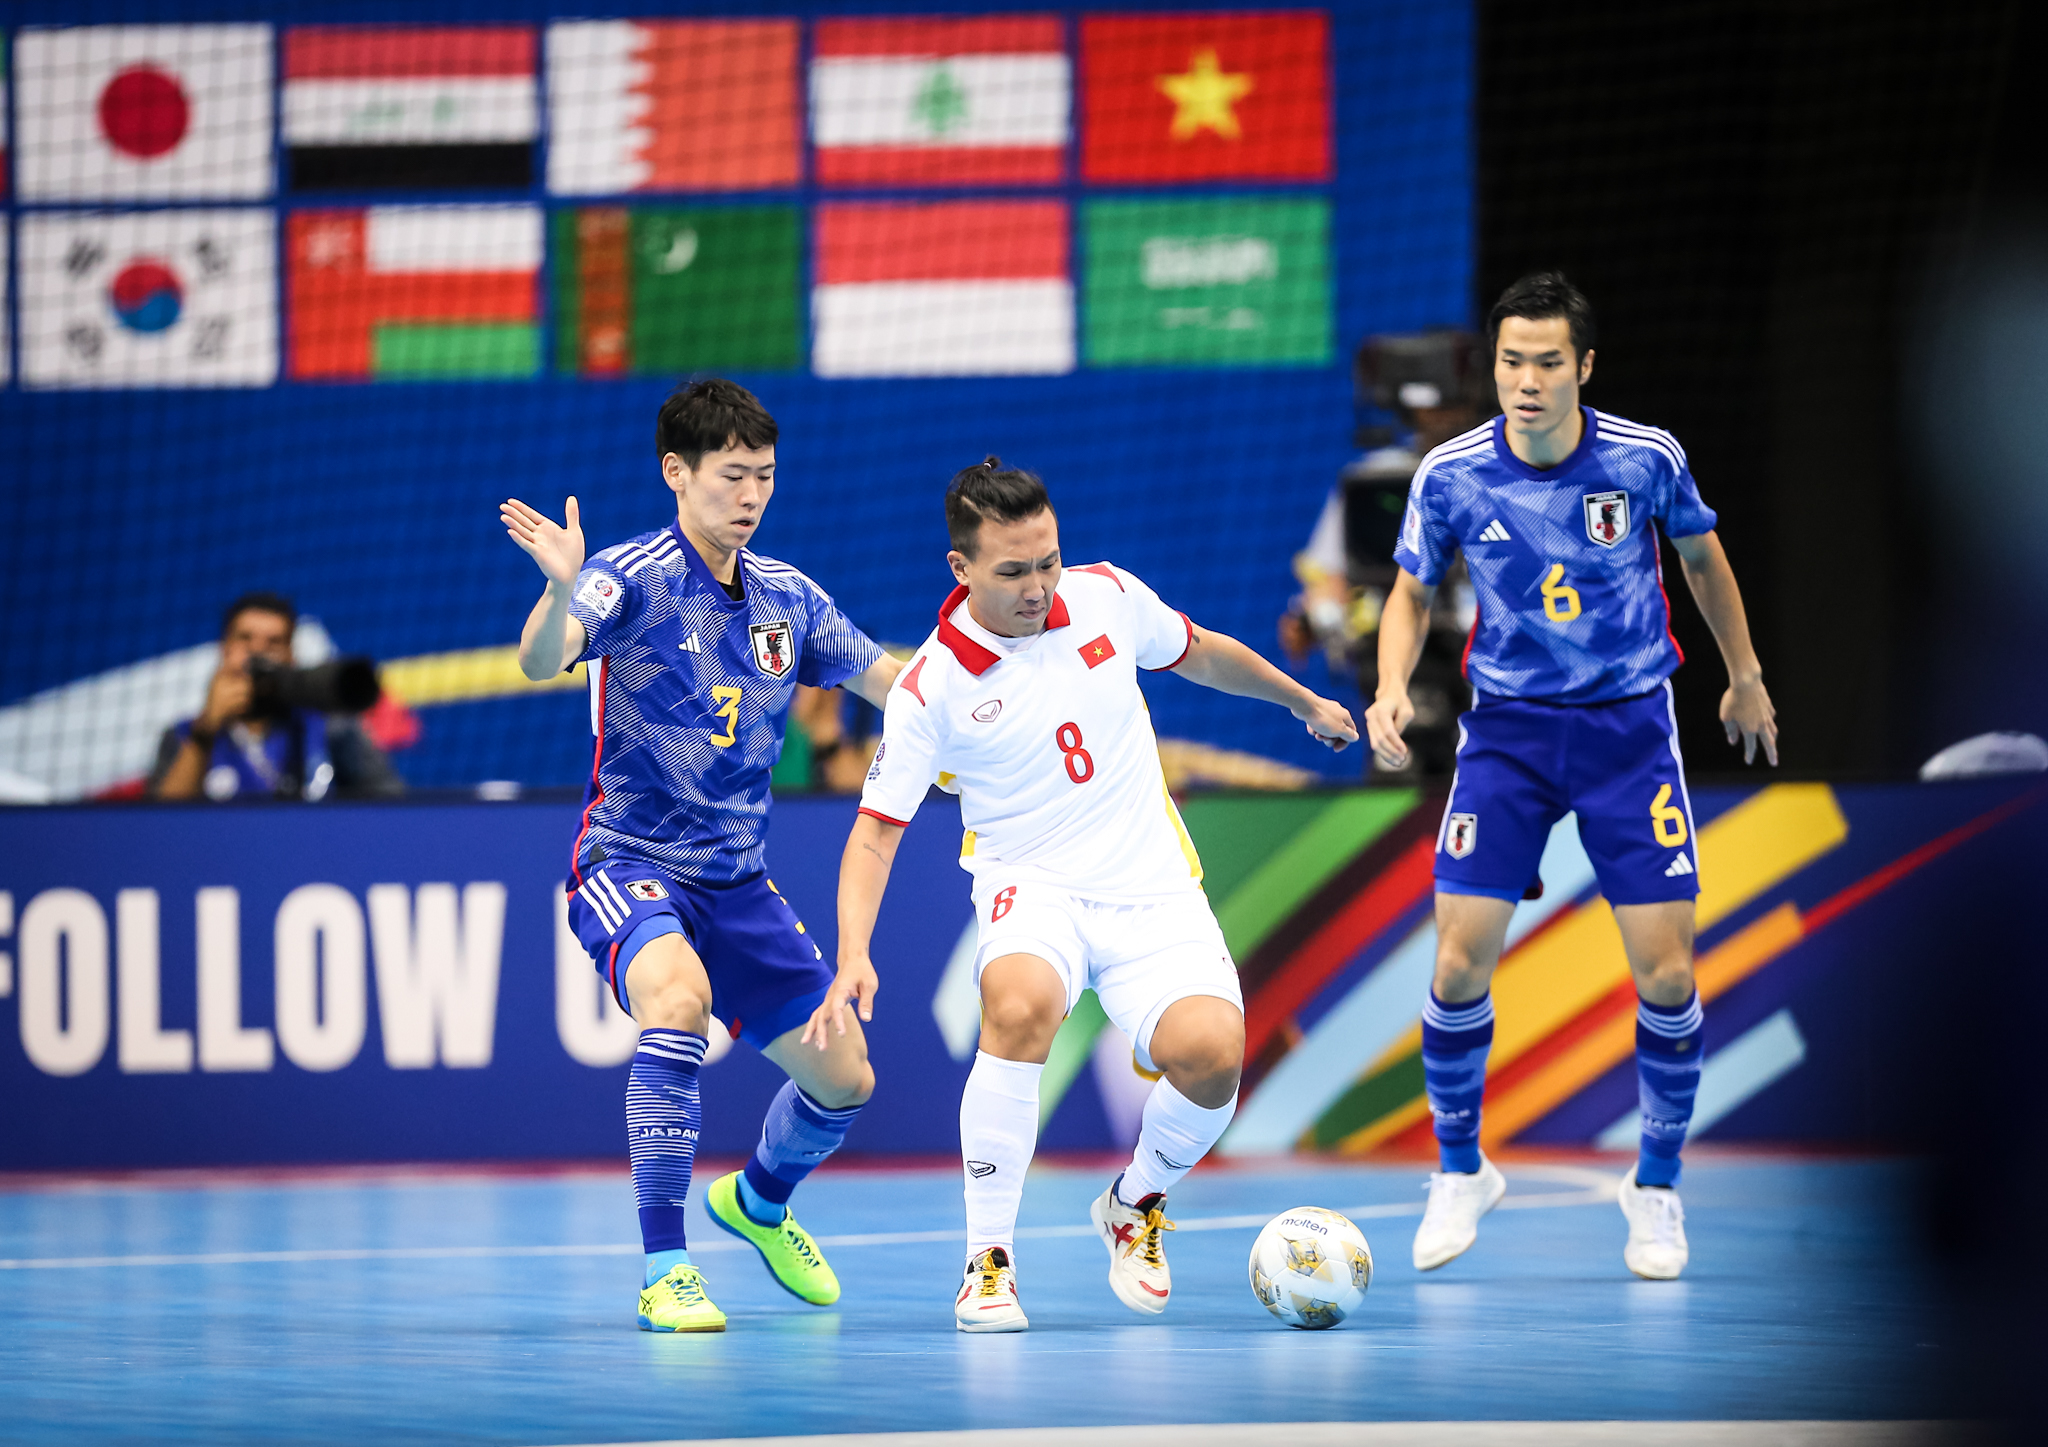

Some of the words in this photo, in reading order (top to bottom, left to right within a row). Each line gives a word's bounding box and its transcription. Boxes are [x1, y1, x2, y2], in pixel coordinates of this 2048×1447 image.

[1540, 563, 1582, 622] 6
[760, 623, 781, 631] JAPAN
[711, 685, 743, 747] 3
[1055, 722, 1095, 784] 8
[1650, 783, 1688, 848] 6
[991, 886, 1017, 923] 8
[0, 881, 505, 1076] OLLOW
[640, 1127, 699, 1140] JAPAN
[1281, 1218, 1328, 1236] molten
